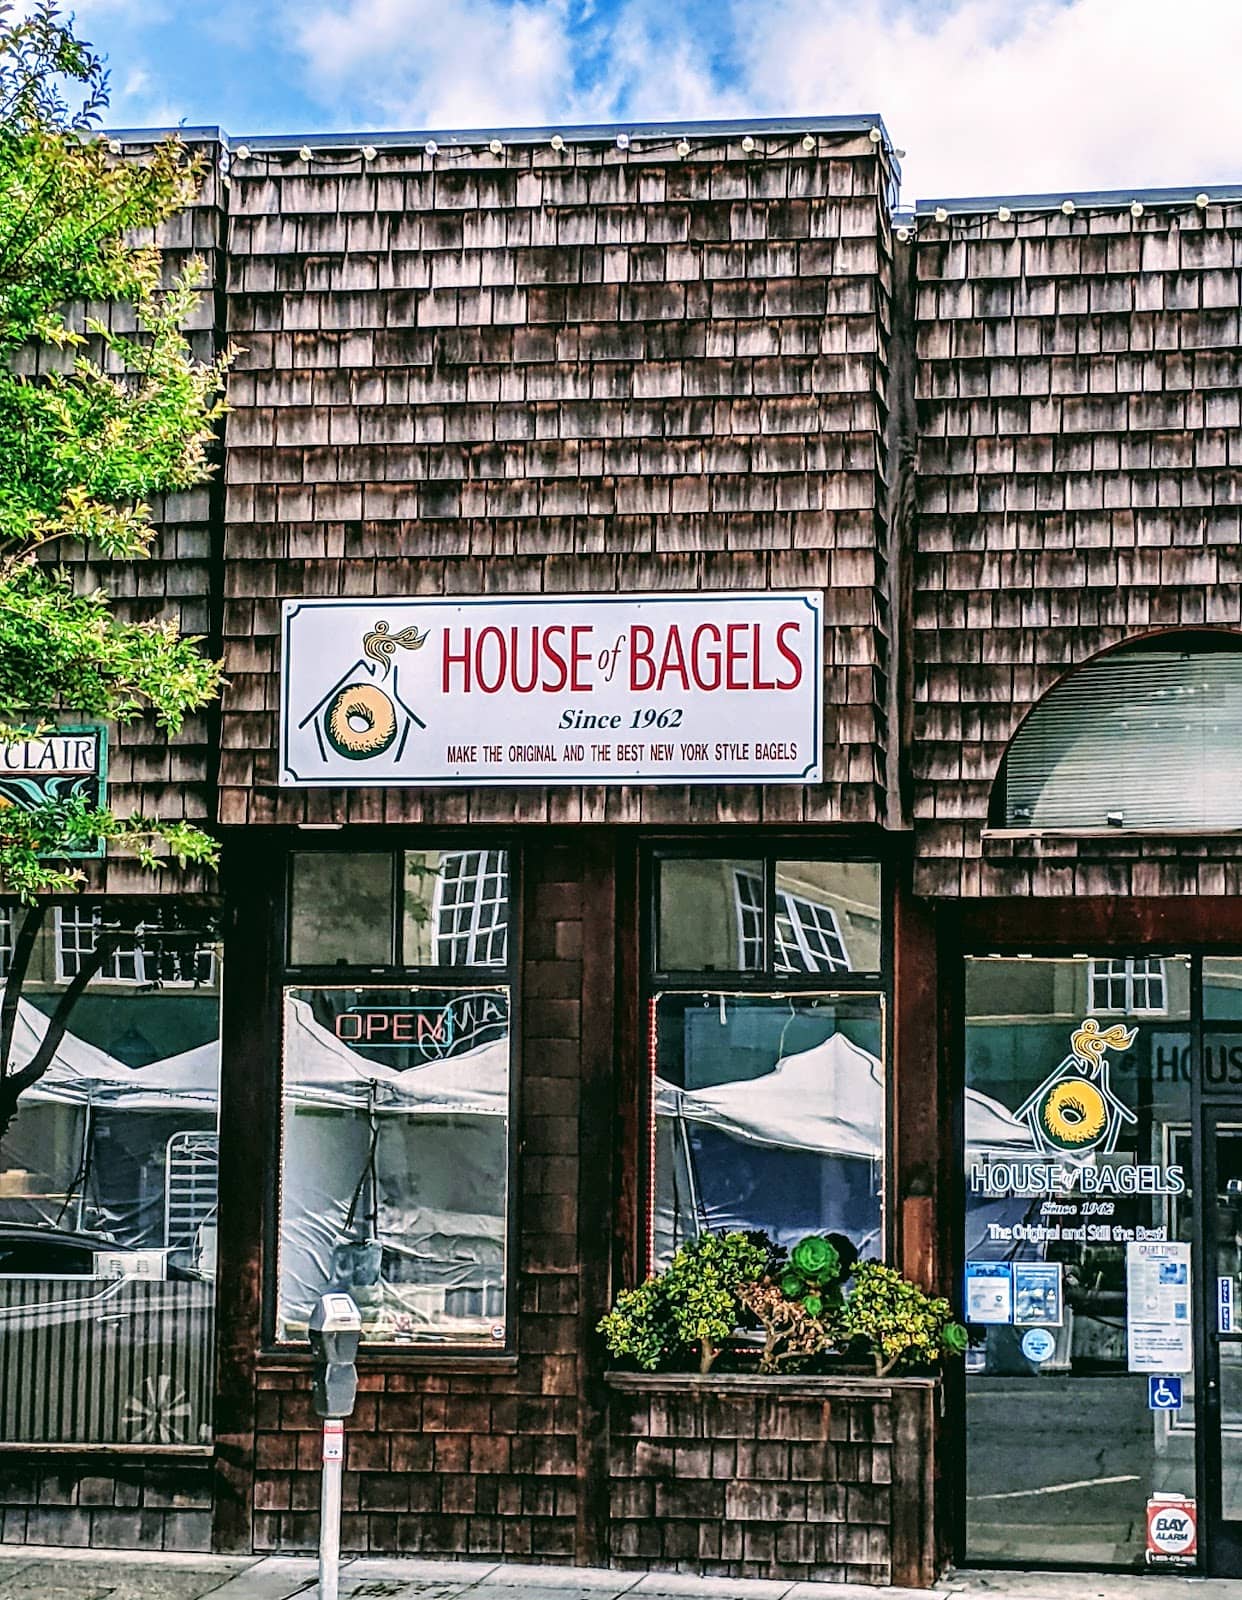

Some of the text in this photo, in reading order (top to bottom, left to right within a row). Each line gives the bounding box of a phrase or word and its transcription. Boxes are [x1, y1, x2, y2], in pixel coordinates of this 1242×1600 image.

[441, 621, 803, 694] HOUSE of BAGELS
[558, 707, 684, 730] Since 1962
[0, 739, 93, 769] CLAIR
[446, 742, 798, 764] MAKE THE ORIGINAL AND THE BEST NEW YORK STYLE BAGELS
[335, 1013, 444, 1041] OPEN
[970, 1163, 1062, 1193] HOUSE
[1080, 1165, 1186, 1194] BAGELS
[1039, 1201, 1116, 1217] Since 1962
[987, 1223, 1012, 1241] The
[1012, 1223, 1060, 1244] Original
[1061, 1224, 1086, 1241] and
[1087, 1224, 1111, 1241] Still
[1112, 1225, 1135, 1241] the
[1156, 1518, 1189, 1531] BAY
[1156, 1532, 1188, 1540] ALARM
